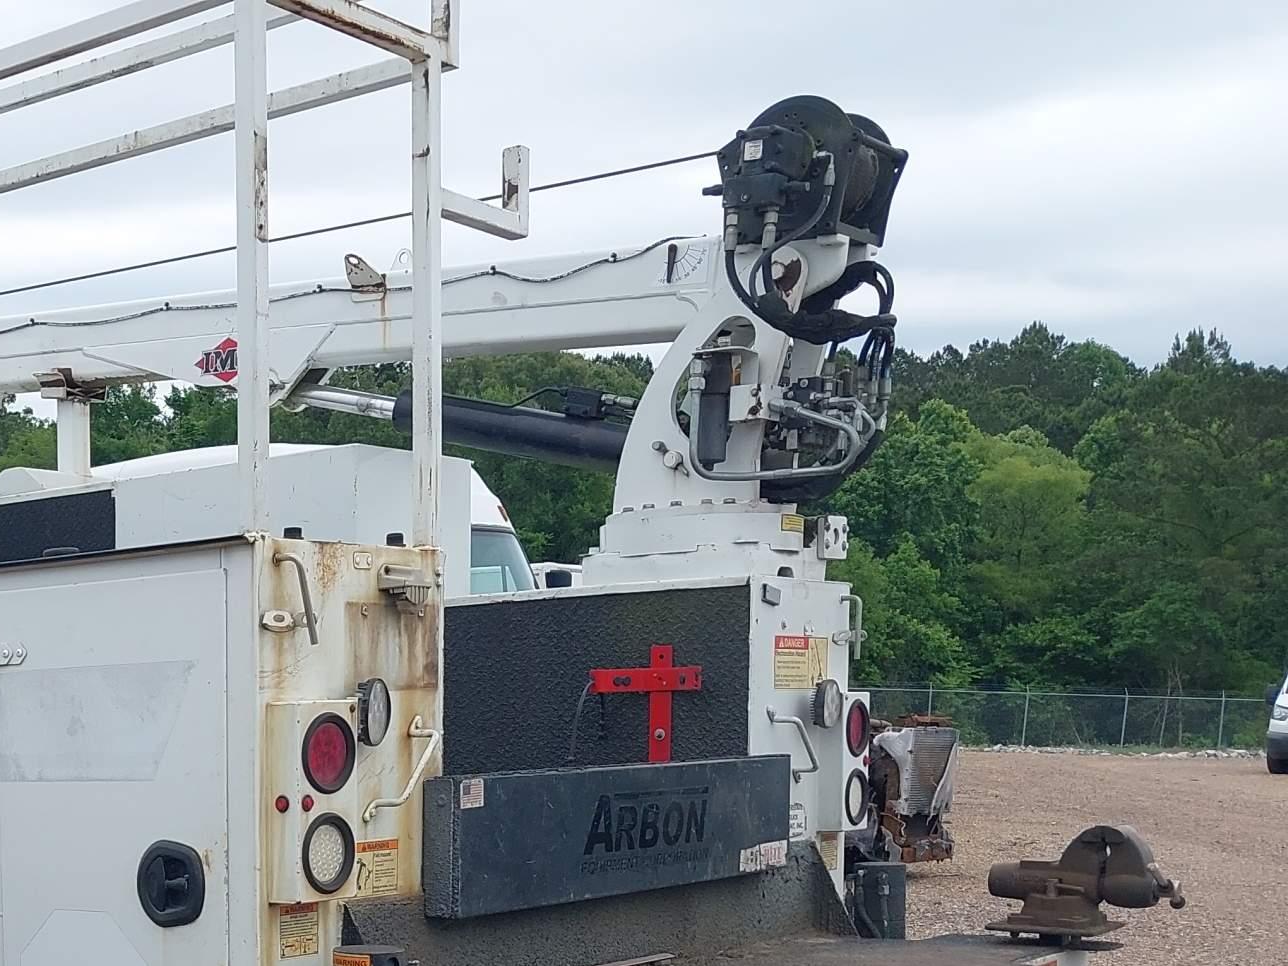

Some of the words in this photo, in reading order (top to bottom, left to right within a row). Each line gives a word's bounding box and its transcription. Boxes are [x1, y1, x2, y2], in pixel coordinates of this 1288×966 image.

[202, 349, 238, 374] IM
[785, 639, 805, 648] DANGER
[583, 793, 709, 856] ARBON
